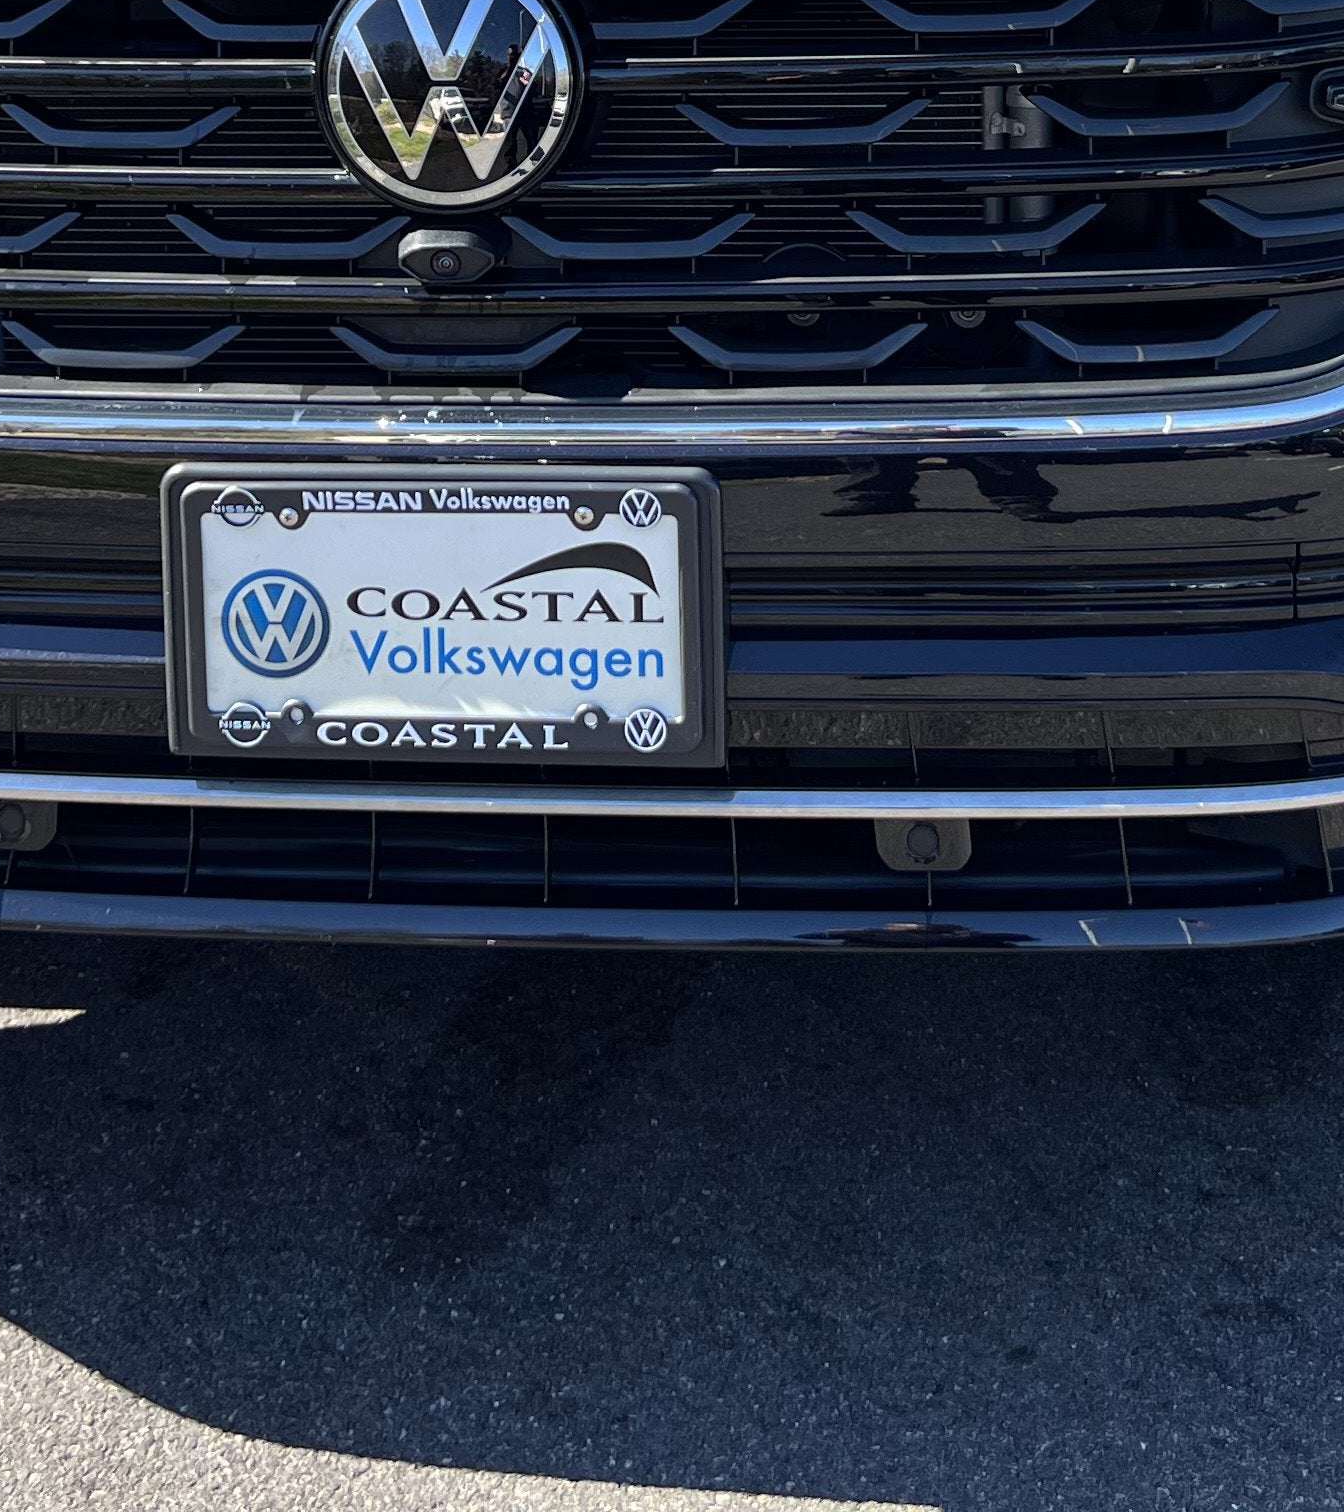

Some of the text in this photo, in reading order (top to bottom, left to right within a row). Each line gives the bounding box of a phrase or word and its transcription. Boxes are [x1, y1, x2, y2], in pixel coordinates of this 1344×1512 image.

[211, 503, 265, 513] NISSAN
[302, 488, 570, 513] NISSAN Volkswagen
[346, 586, 664, 624] COASTAL
[350, 626, 664, 690] Volkswagen
[219, 719, 271, 730] NISSAN
[316, 721, 568, 750] COASTAL
